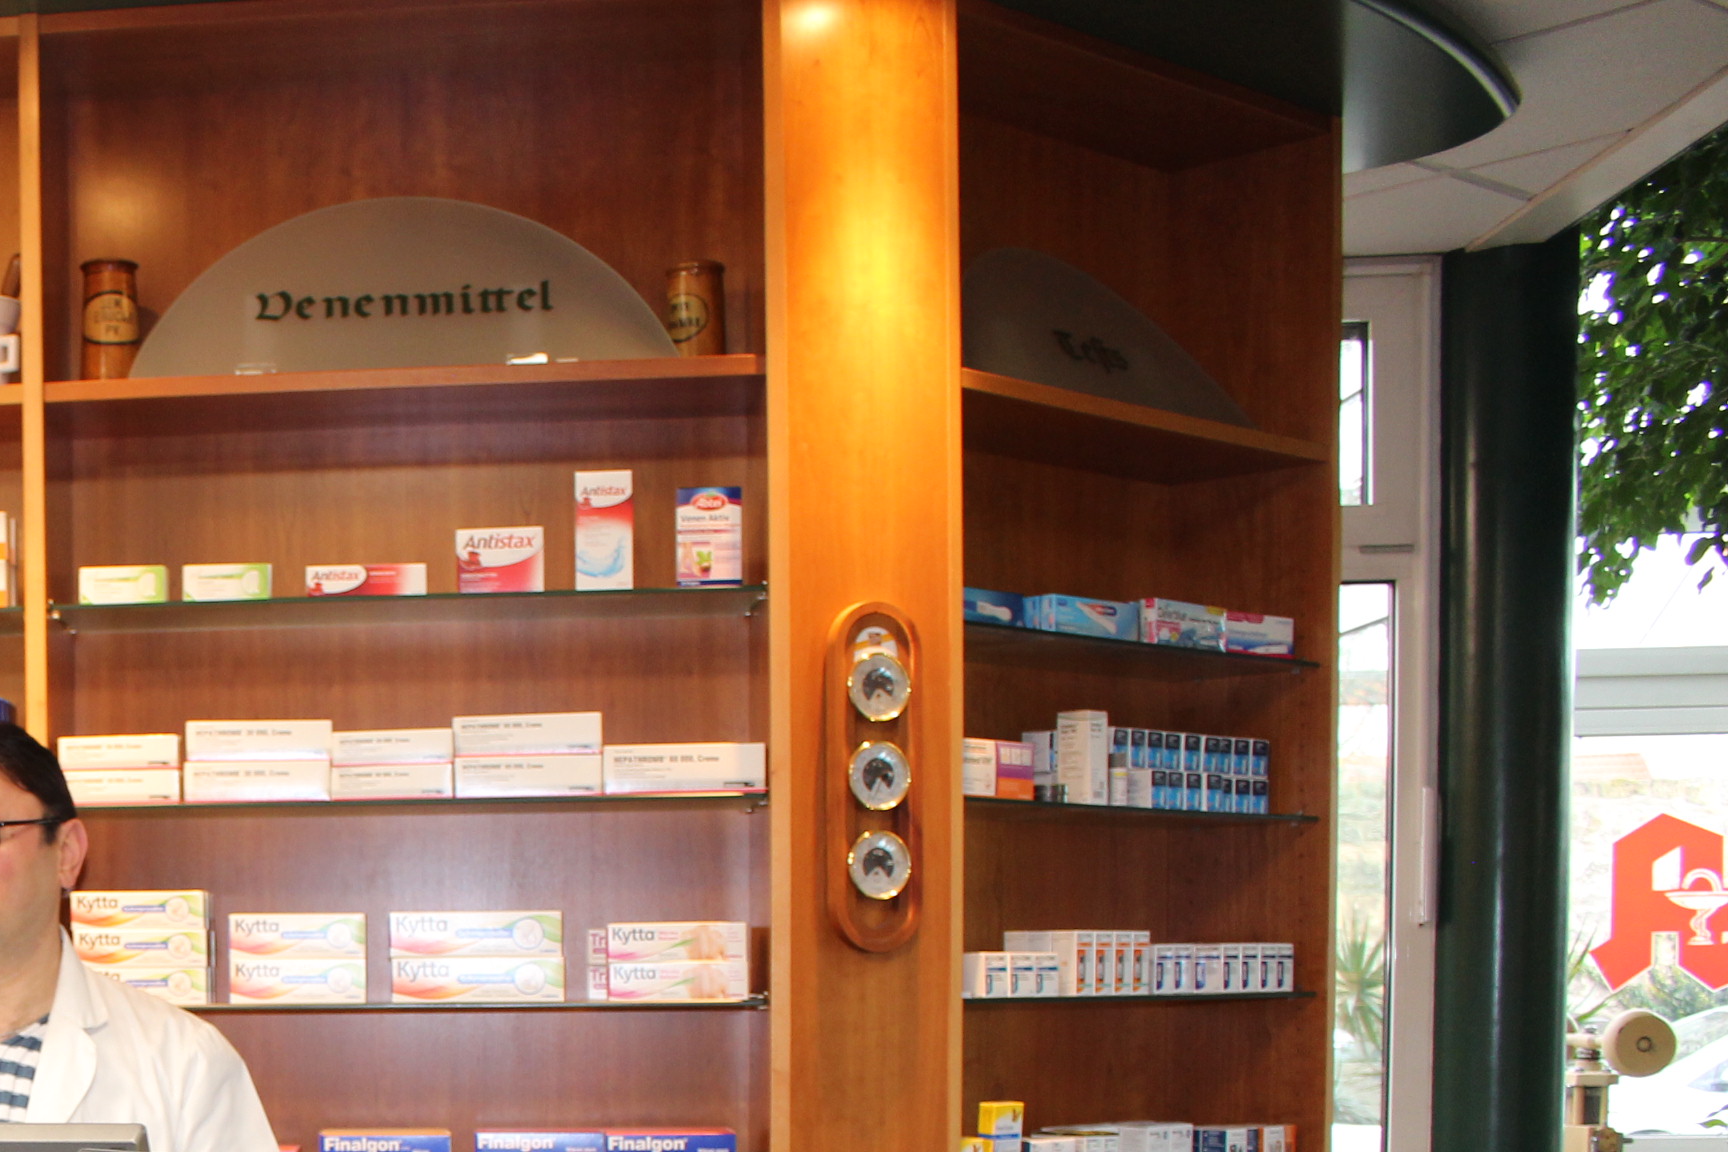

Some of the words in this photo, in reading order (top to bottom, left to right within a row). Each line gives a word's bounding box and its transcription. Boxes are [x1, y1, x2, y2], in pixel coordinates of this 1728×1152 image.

[255, 280, 554, 321] Venenmittel
[580, 485, 627, 497] Antistax
[463, 532, 537, 550] Antistax
[311, 569, 360, 583] Antistax
[76, 894, 118, 912] Kytta
[235, 919, 279, 936] Kytta
[396, 915, 449, 936] Kytta
[79, 932, 121, 950] Kytta
[612, 926, 655, 944] Kytta
[235, 963, 280, 981] Kytta
[397, 961, 450, 981] Kytta
[613, 965, 656, 983] Kytta
[476, 1132, 553, 1152] Finalgon
